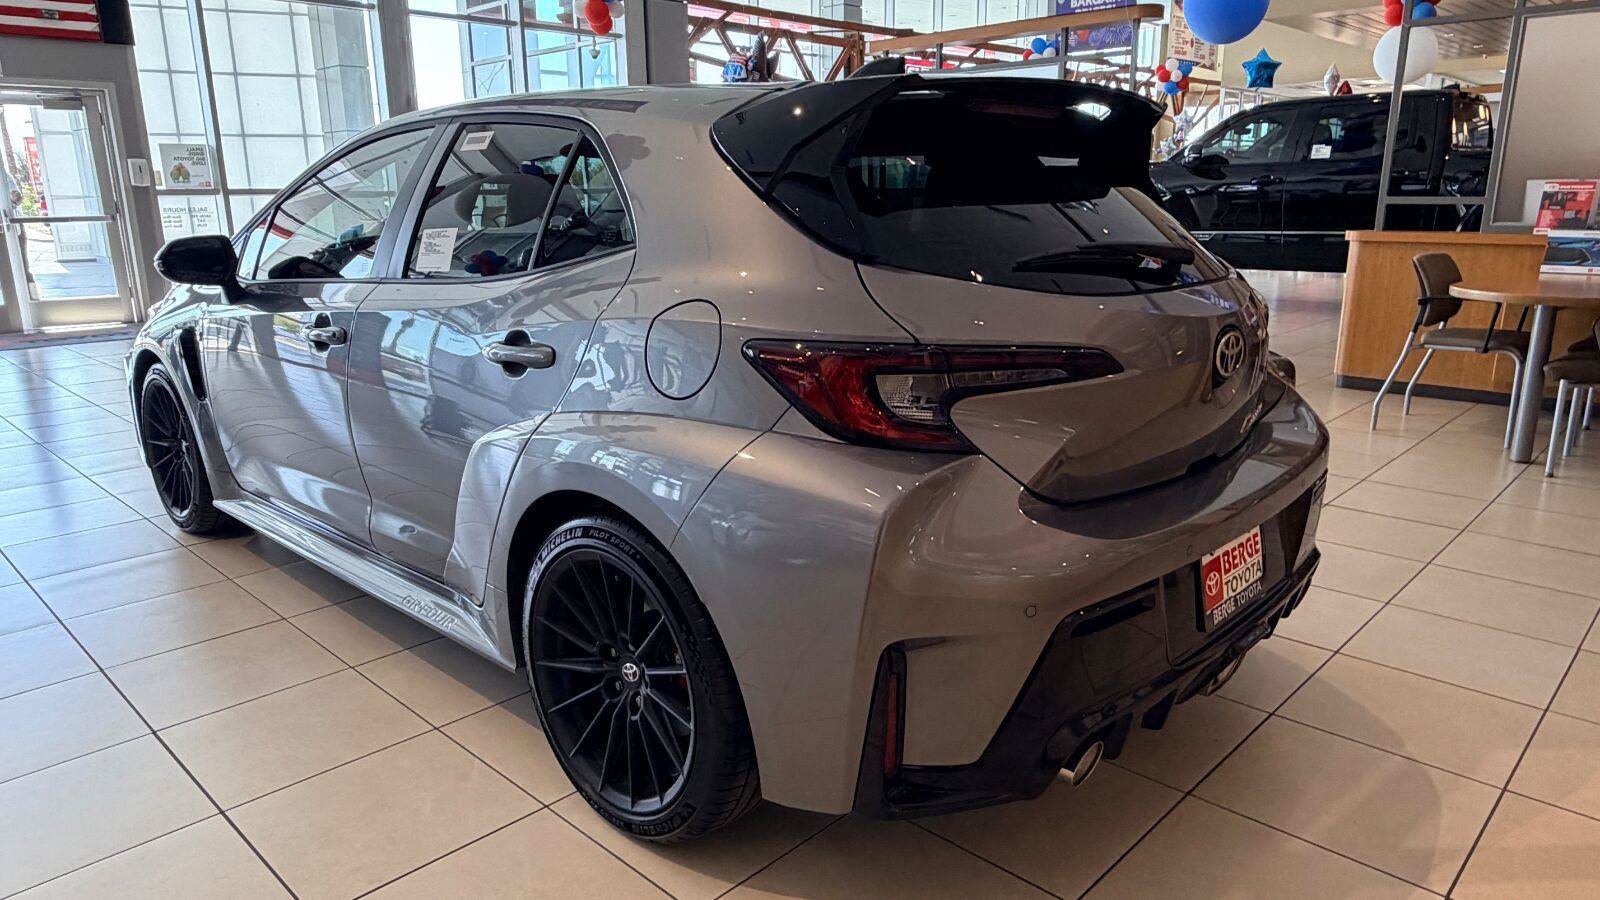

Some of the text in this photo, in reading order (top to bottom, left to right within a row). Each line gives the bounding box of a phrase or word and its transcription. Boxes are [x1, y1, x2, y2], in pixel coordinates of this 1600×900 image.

[541, 527, 636, 561] MICHELIN PILOT SPORT
[1221, 531, 1260, 576] BERGE
[1224, 559, 1262, 597] TOYOTA
[1212, 580, 1262, 625] BERGE TOYOTA
